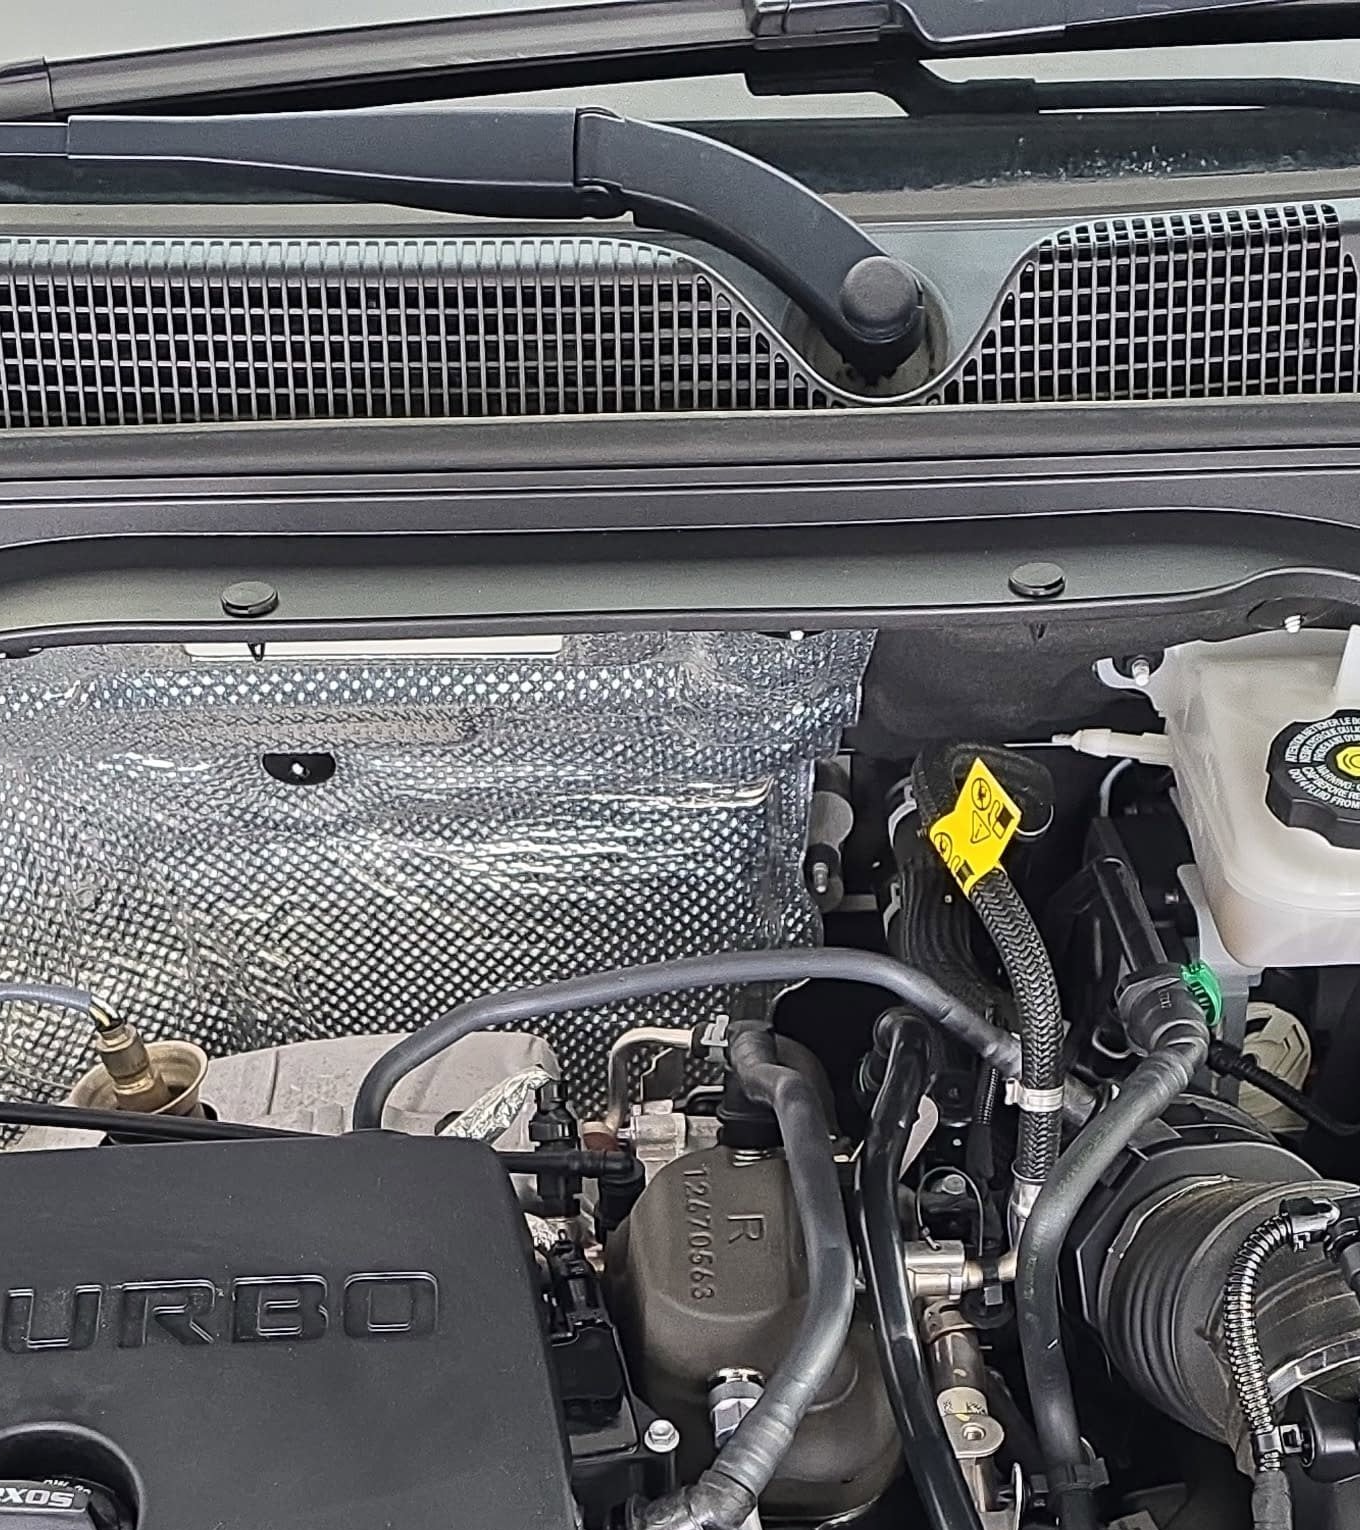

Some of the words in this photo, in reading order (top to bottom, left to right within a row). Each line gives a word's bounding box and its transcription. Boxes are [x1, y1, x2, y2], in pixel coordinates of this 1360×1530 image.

[1339, 716, 1351, 725] LE
[1302, 767, 1320, 780] CAP
[1312, 778, 1349, 798] BEFORE
[1303, 783, 1331, 800] FLUID
[1330, 796, 1360, 809] FROM
[726, 1214, 766, 1245] R
